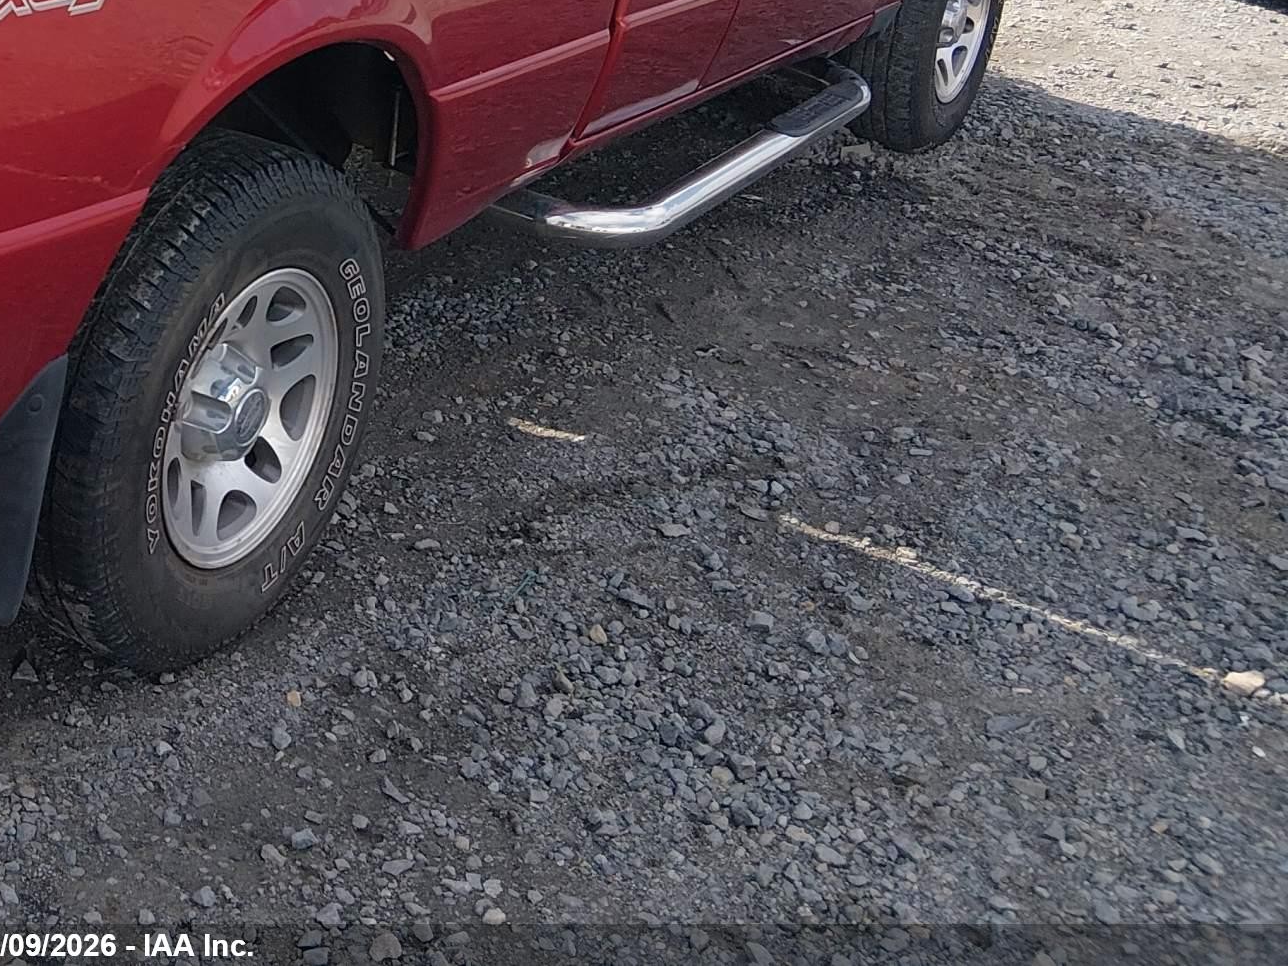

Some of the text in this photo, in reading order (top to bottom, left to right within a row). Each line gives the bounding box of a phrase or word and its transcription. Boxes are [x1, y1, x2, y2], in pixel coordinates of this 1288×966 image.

[145, 292, 226, 555] YOKOHAMA
[261, 257, 372, 592] GEOLANDAR A/T
